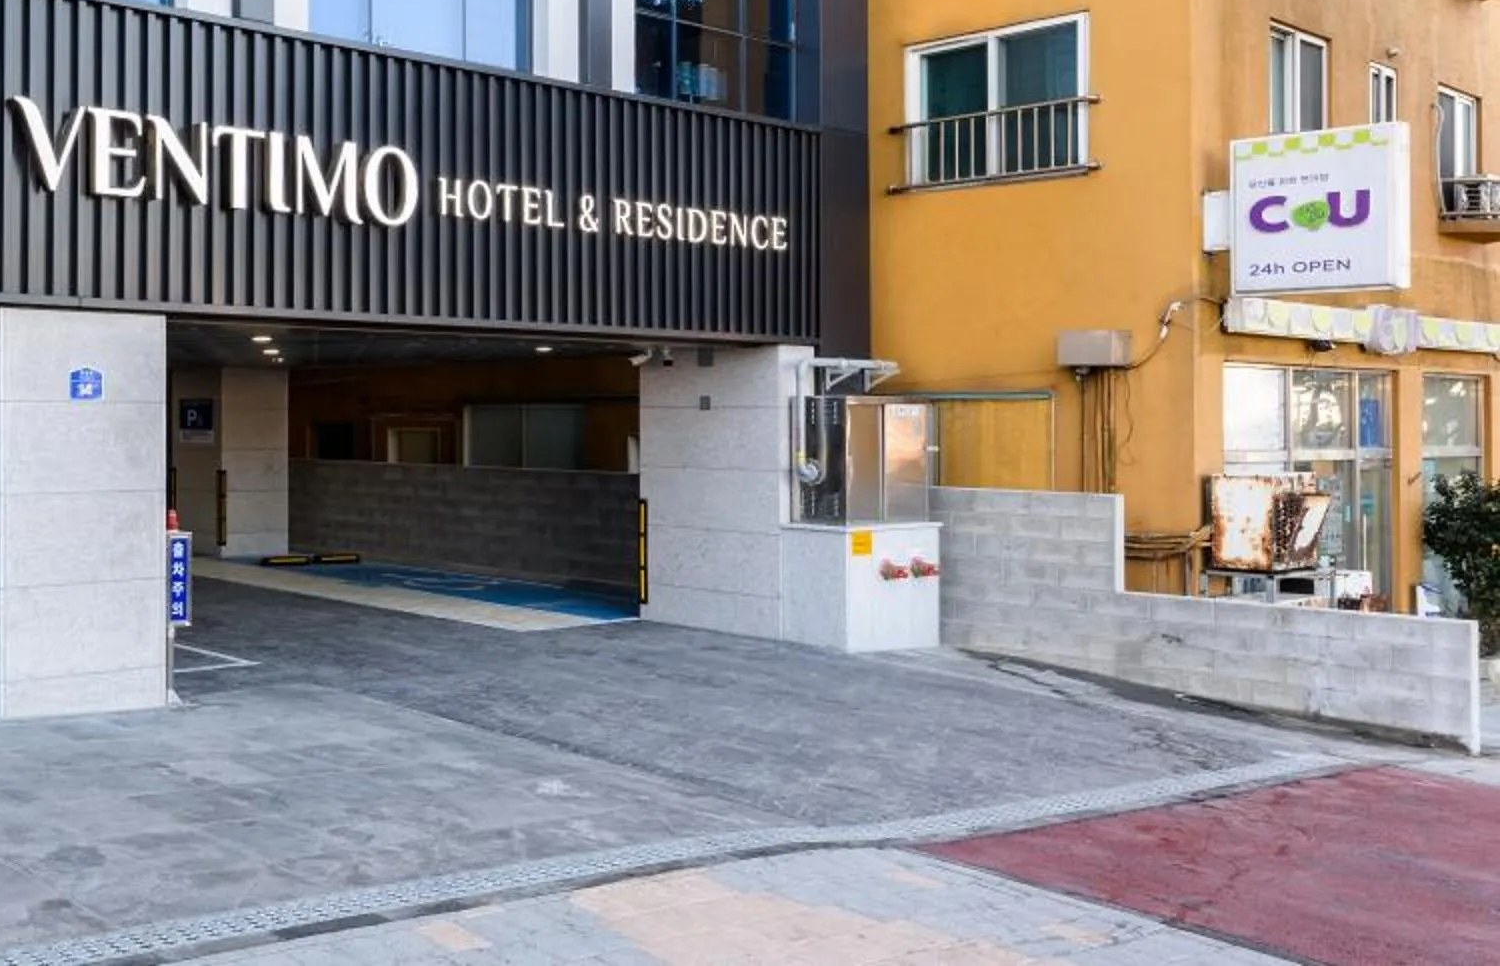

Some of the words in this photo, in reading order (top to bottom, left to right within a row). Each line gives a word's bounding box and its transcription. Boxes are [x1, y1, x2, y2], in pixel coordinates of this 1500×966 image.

[13, 93, 419, 227] VENTIMO
[438, 176, 565, 228] HOTEL
[579, 193, 600, 233] &
[613, 197, 789, 252] RESIDENCE
[1249, 188, 1371, 233] CU
[1249, 263, 1285, 277] 24h
[1291, 258, 1351, 274] OPEN
[172, 541, 185, 616] 출차주의
